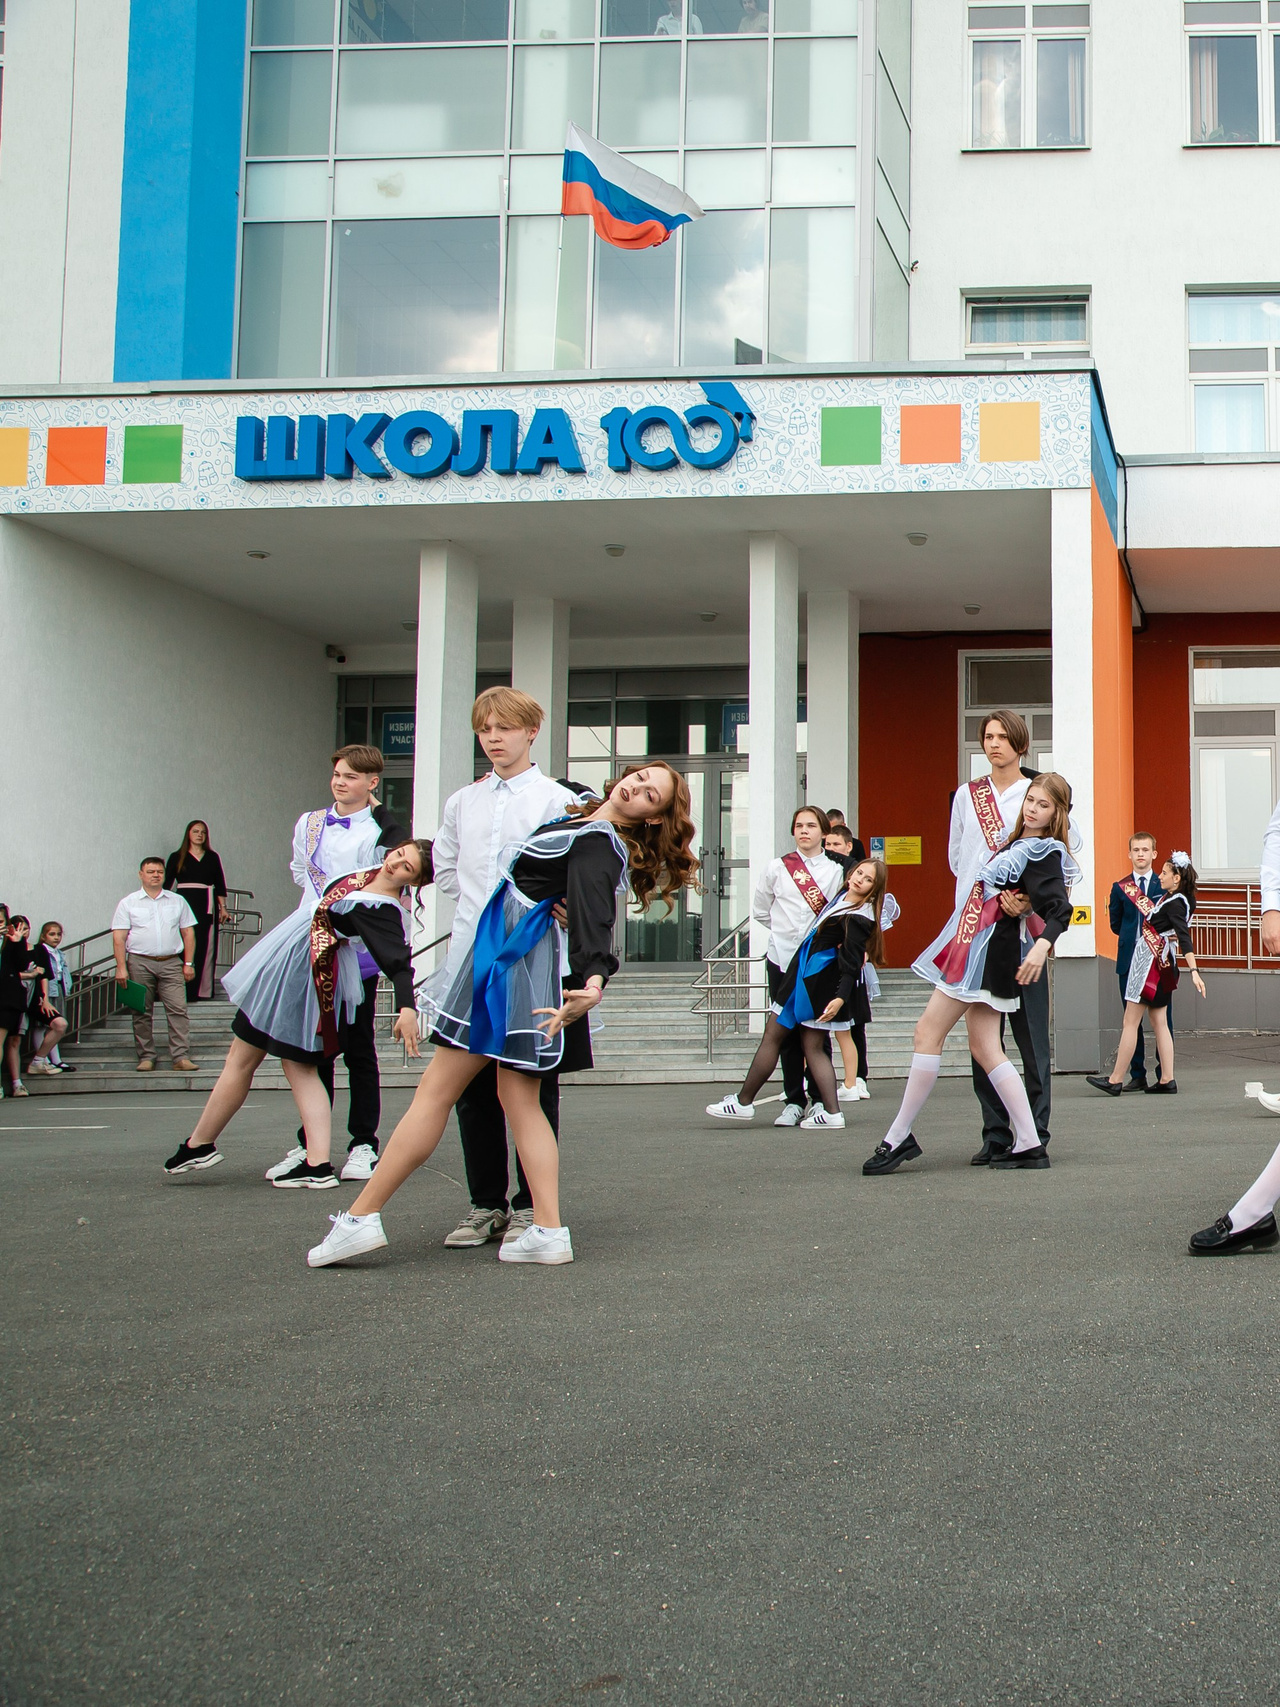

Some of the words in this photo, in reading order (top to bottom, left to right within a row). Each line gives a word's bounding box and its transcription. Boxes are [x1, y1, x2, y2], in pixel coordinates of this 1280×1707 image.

[235, 407, 587, 481] ШКОЛА
[600, 404, 739, 473] 100
[961, 903, 982, 944] 2023
[321, 971, 334, 1012] 2023
